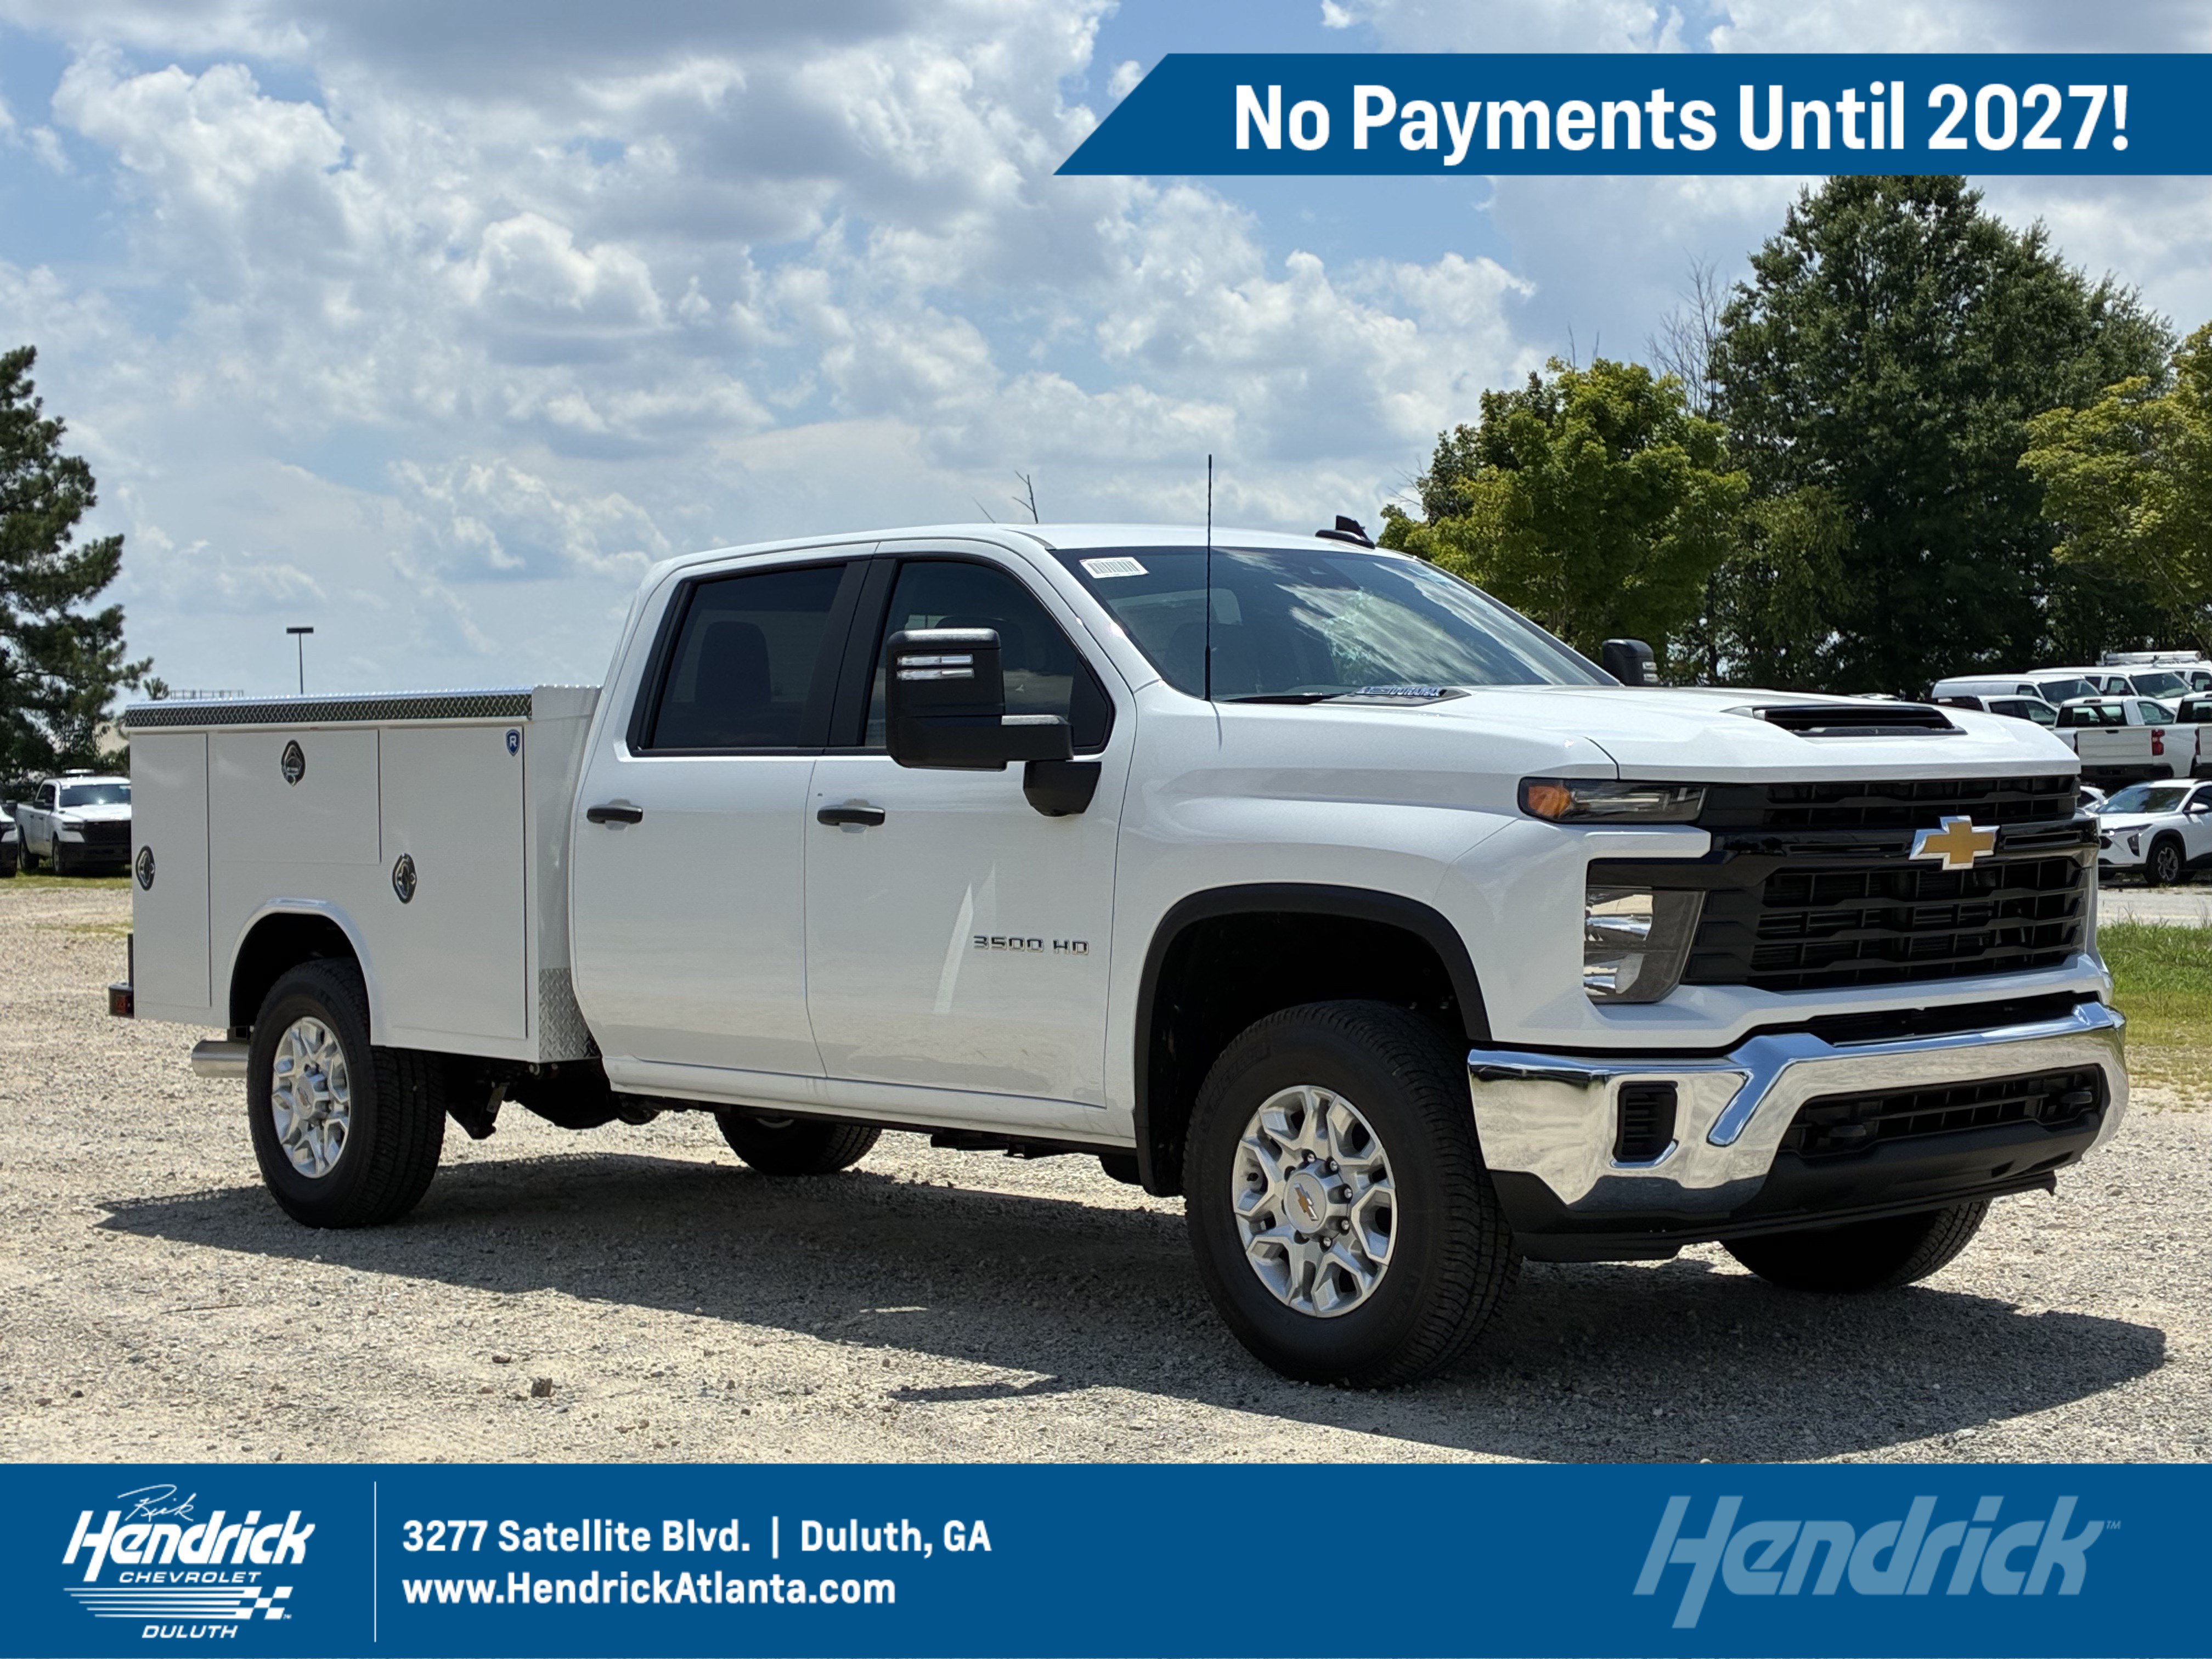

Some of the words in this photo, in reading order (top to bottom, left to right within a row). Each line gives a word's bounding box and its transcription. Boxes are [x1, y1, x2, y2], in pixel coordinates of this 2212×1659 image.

[509, 735, 517, 748] R
[973, 934, 1044, 953] 3500
[1052, 939, 1090, 956] HD
